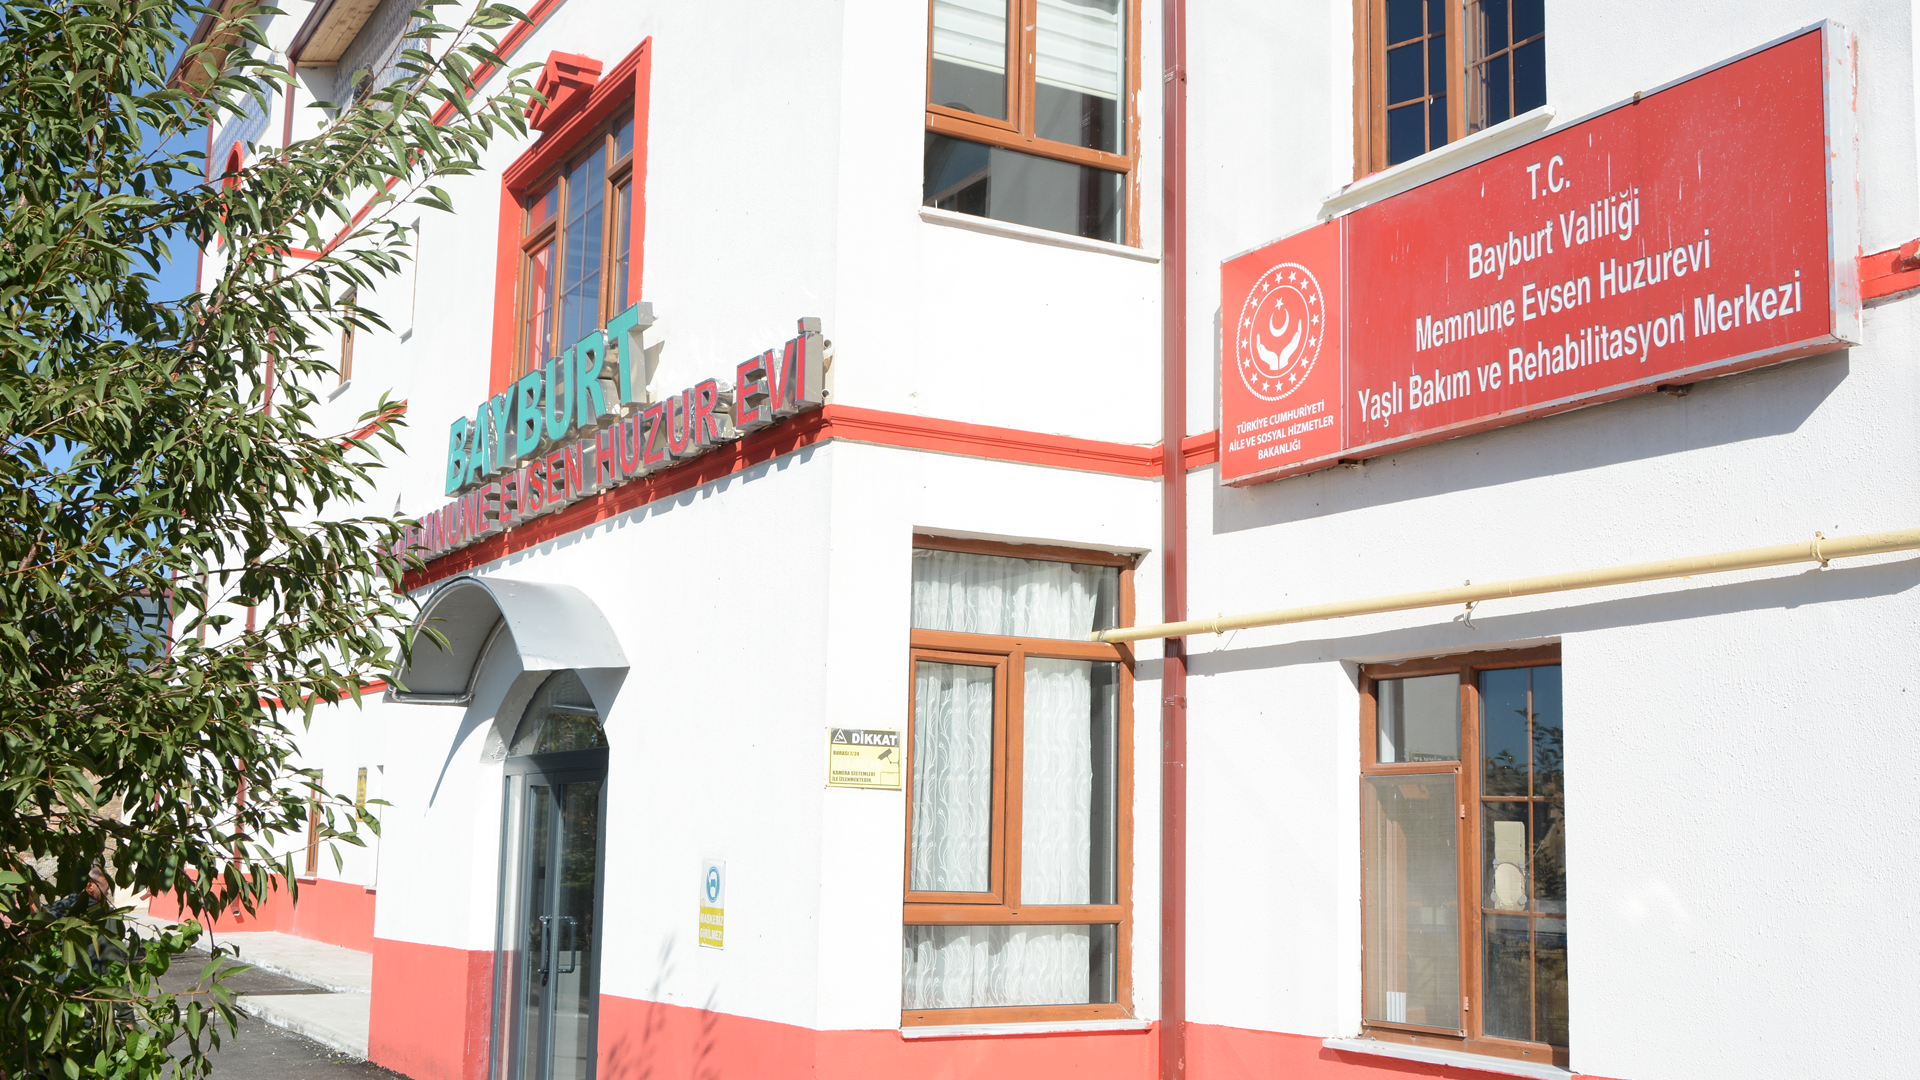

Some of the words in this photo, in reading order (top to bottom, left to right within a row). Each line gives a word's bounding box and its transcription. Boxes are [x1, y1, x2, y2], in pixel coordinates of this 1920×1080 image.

[1526, 153, 1571, 200] T.C.
[1469, 219, 1553, 280] Bayburt
[1560, 186, 1639, 248] Valiliği
[1416, 298, 1515, 352] Memnune
[1522, 274, 1591, 321] Evsen
[1600, 227, 1710, 299] Huzurevi
[1358, 380, 1402, 427] Yaşlı
[1409, 368, 1470, 411] Bakım
[1477, 361, 1501, 392] ve
[1508, 311, 1686, 385] Rehabilitasyon
[1694, 268, 1801, 337] Merkezi
[445, 302, 646, 497] BAYBURT
[499, 439, 590, 527] EVSEN
[595, 377, 726, 490] HUZUR
[737, 317, 815, 428] EVİ
[1228, 439, 1245, 453] AİLE
[1246, 436, 1256, 448] VE
[1256, 428, 1287, 445] SOSYAL
[1287, 415, 1334, 437] HİZMETLER
[1236, 417, 1269, 435] TÜRKİYE
[1269, 399, 1325, 426] CUMHURİYETİ
[1258, 438, 1301, 460] BAKANLIĞI
[851, 731, 897, 746] DİKKAT
